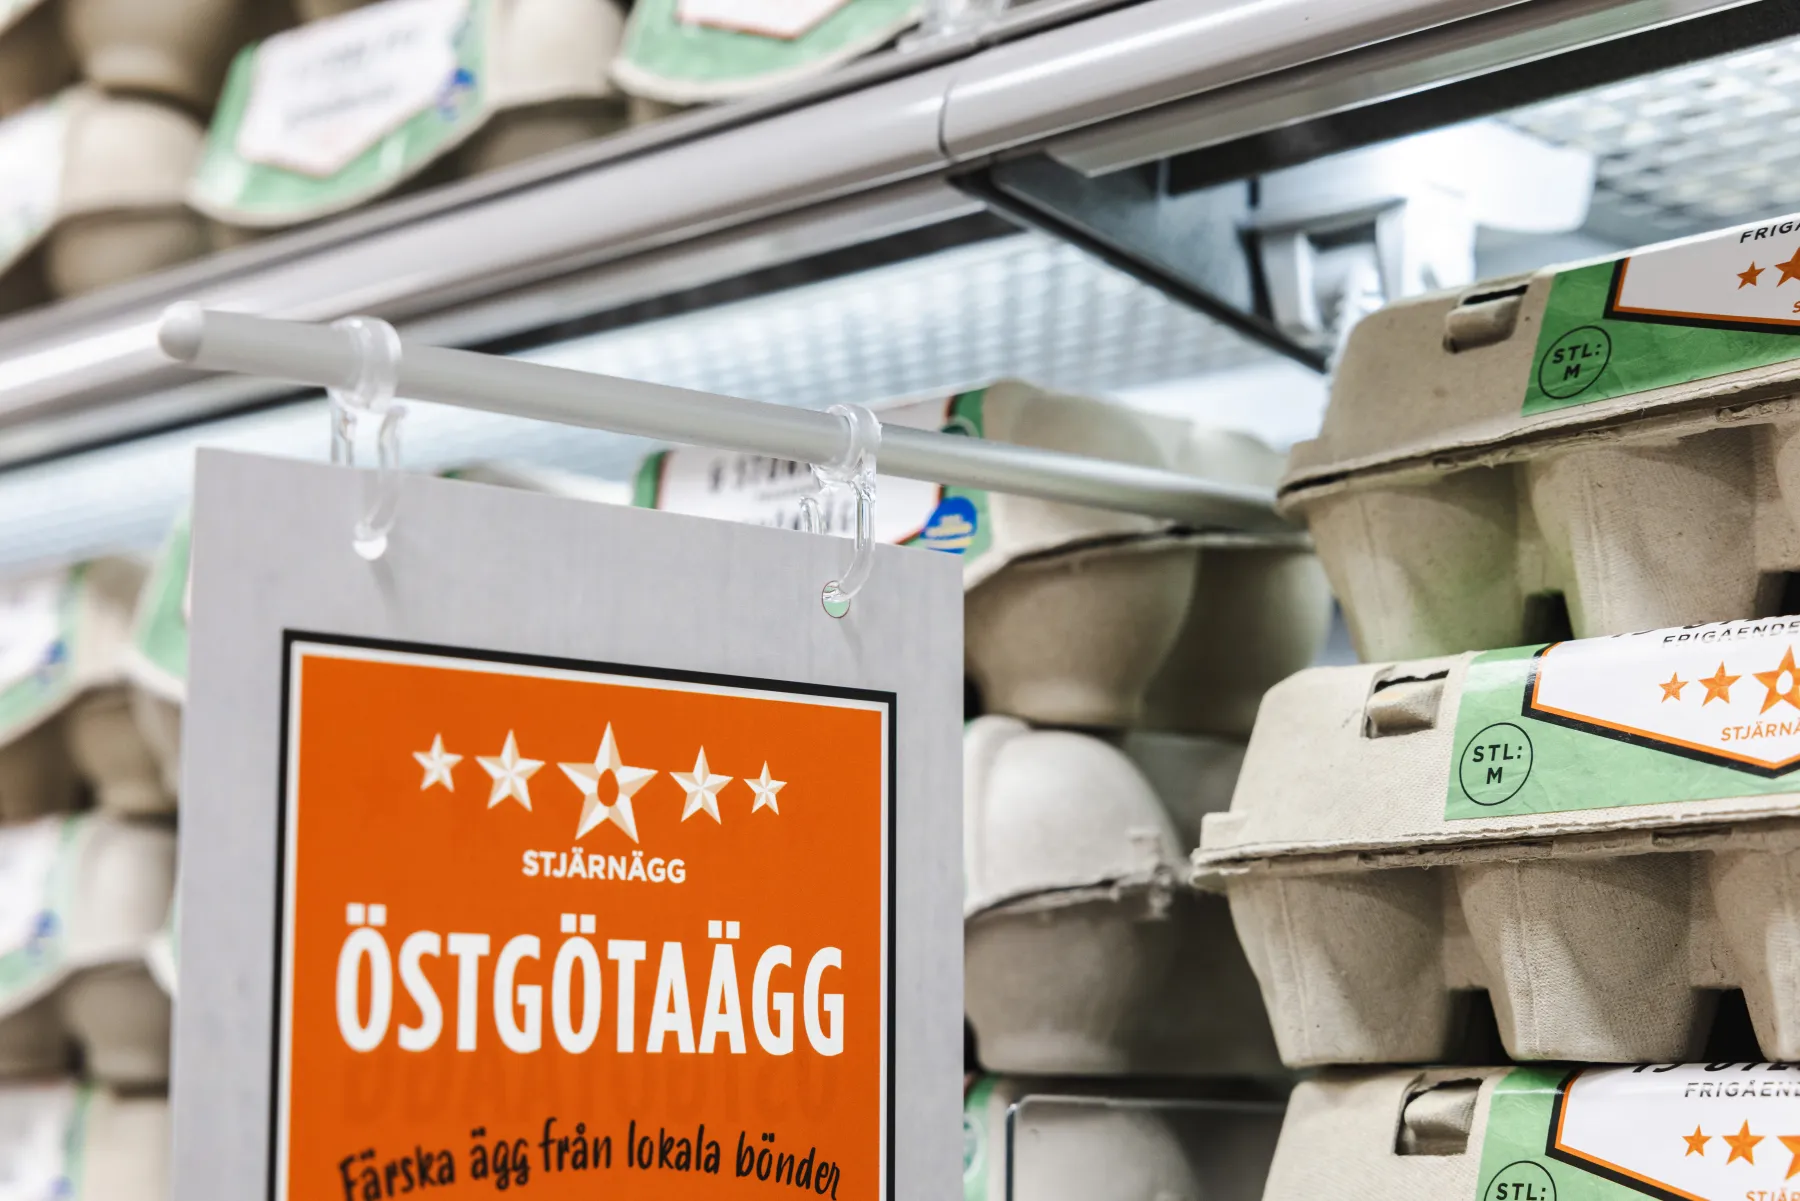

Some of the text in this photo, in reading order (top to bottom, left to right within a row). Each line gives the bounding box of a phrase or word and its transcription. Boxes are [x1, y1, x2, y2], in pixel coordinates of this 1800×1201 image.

[1552, 343, 1602, 364] STL:
[1563, 364, 1581, 381] M
[1472, 743, 1523, 763] STL:
[1486, 766, 1503, 784] M
[522, 849, 687, 884] STJÄRNÄGG
[336, 903, 845, 1056] ÖSTGÖTAÄGG
[338, 1116, 842, 1201] Färska ägg från lokala bönder
[1496, 1183, 1547, 1201] STL:
